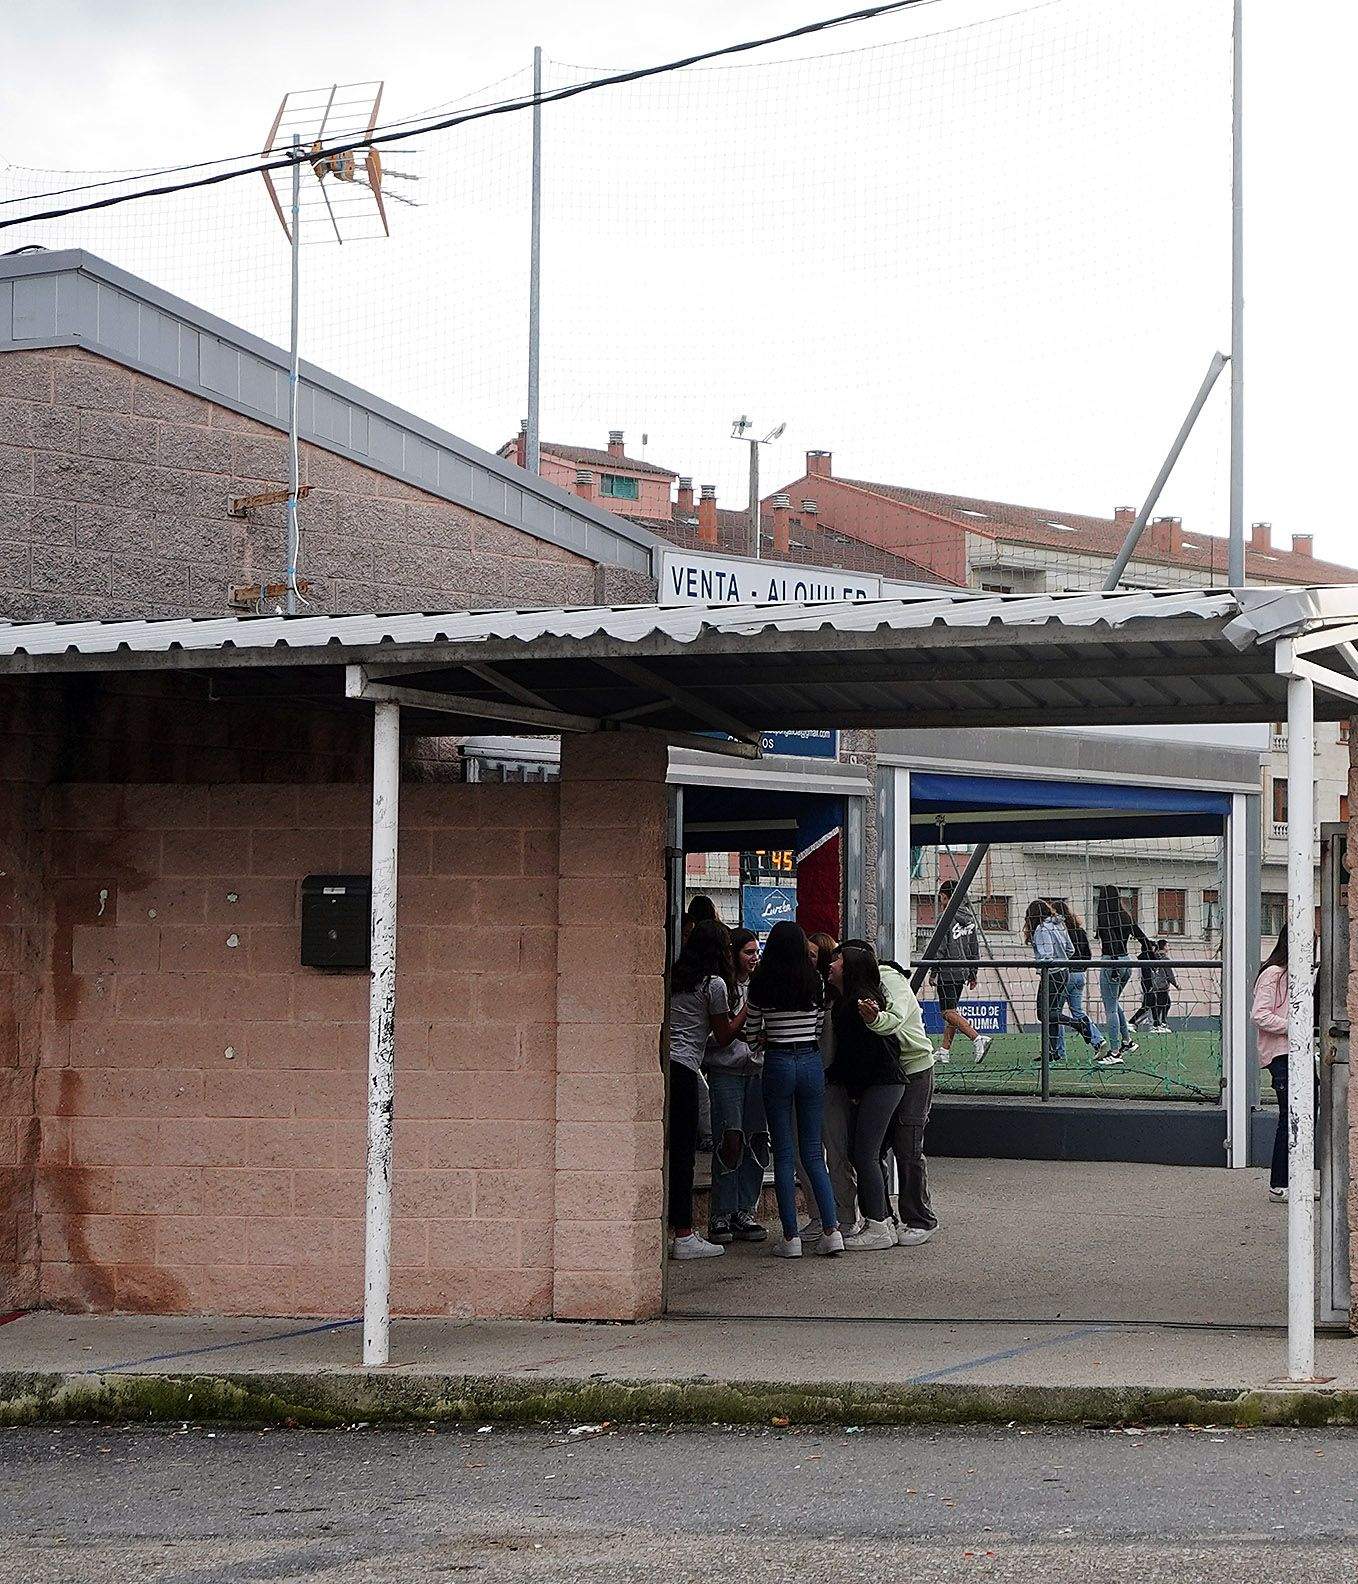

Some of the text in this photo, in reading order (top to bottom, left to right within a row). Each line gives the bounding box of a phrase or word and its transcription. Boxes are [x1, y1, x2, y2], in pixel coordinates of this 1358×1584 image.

[671, 565, 740, 602] VENTA
[956, 1005, 1000, 1017] NCELLO DE
[968, 1017, 1000, 1030] DUMIA
